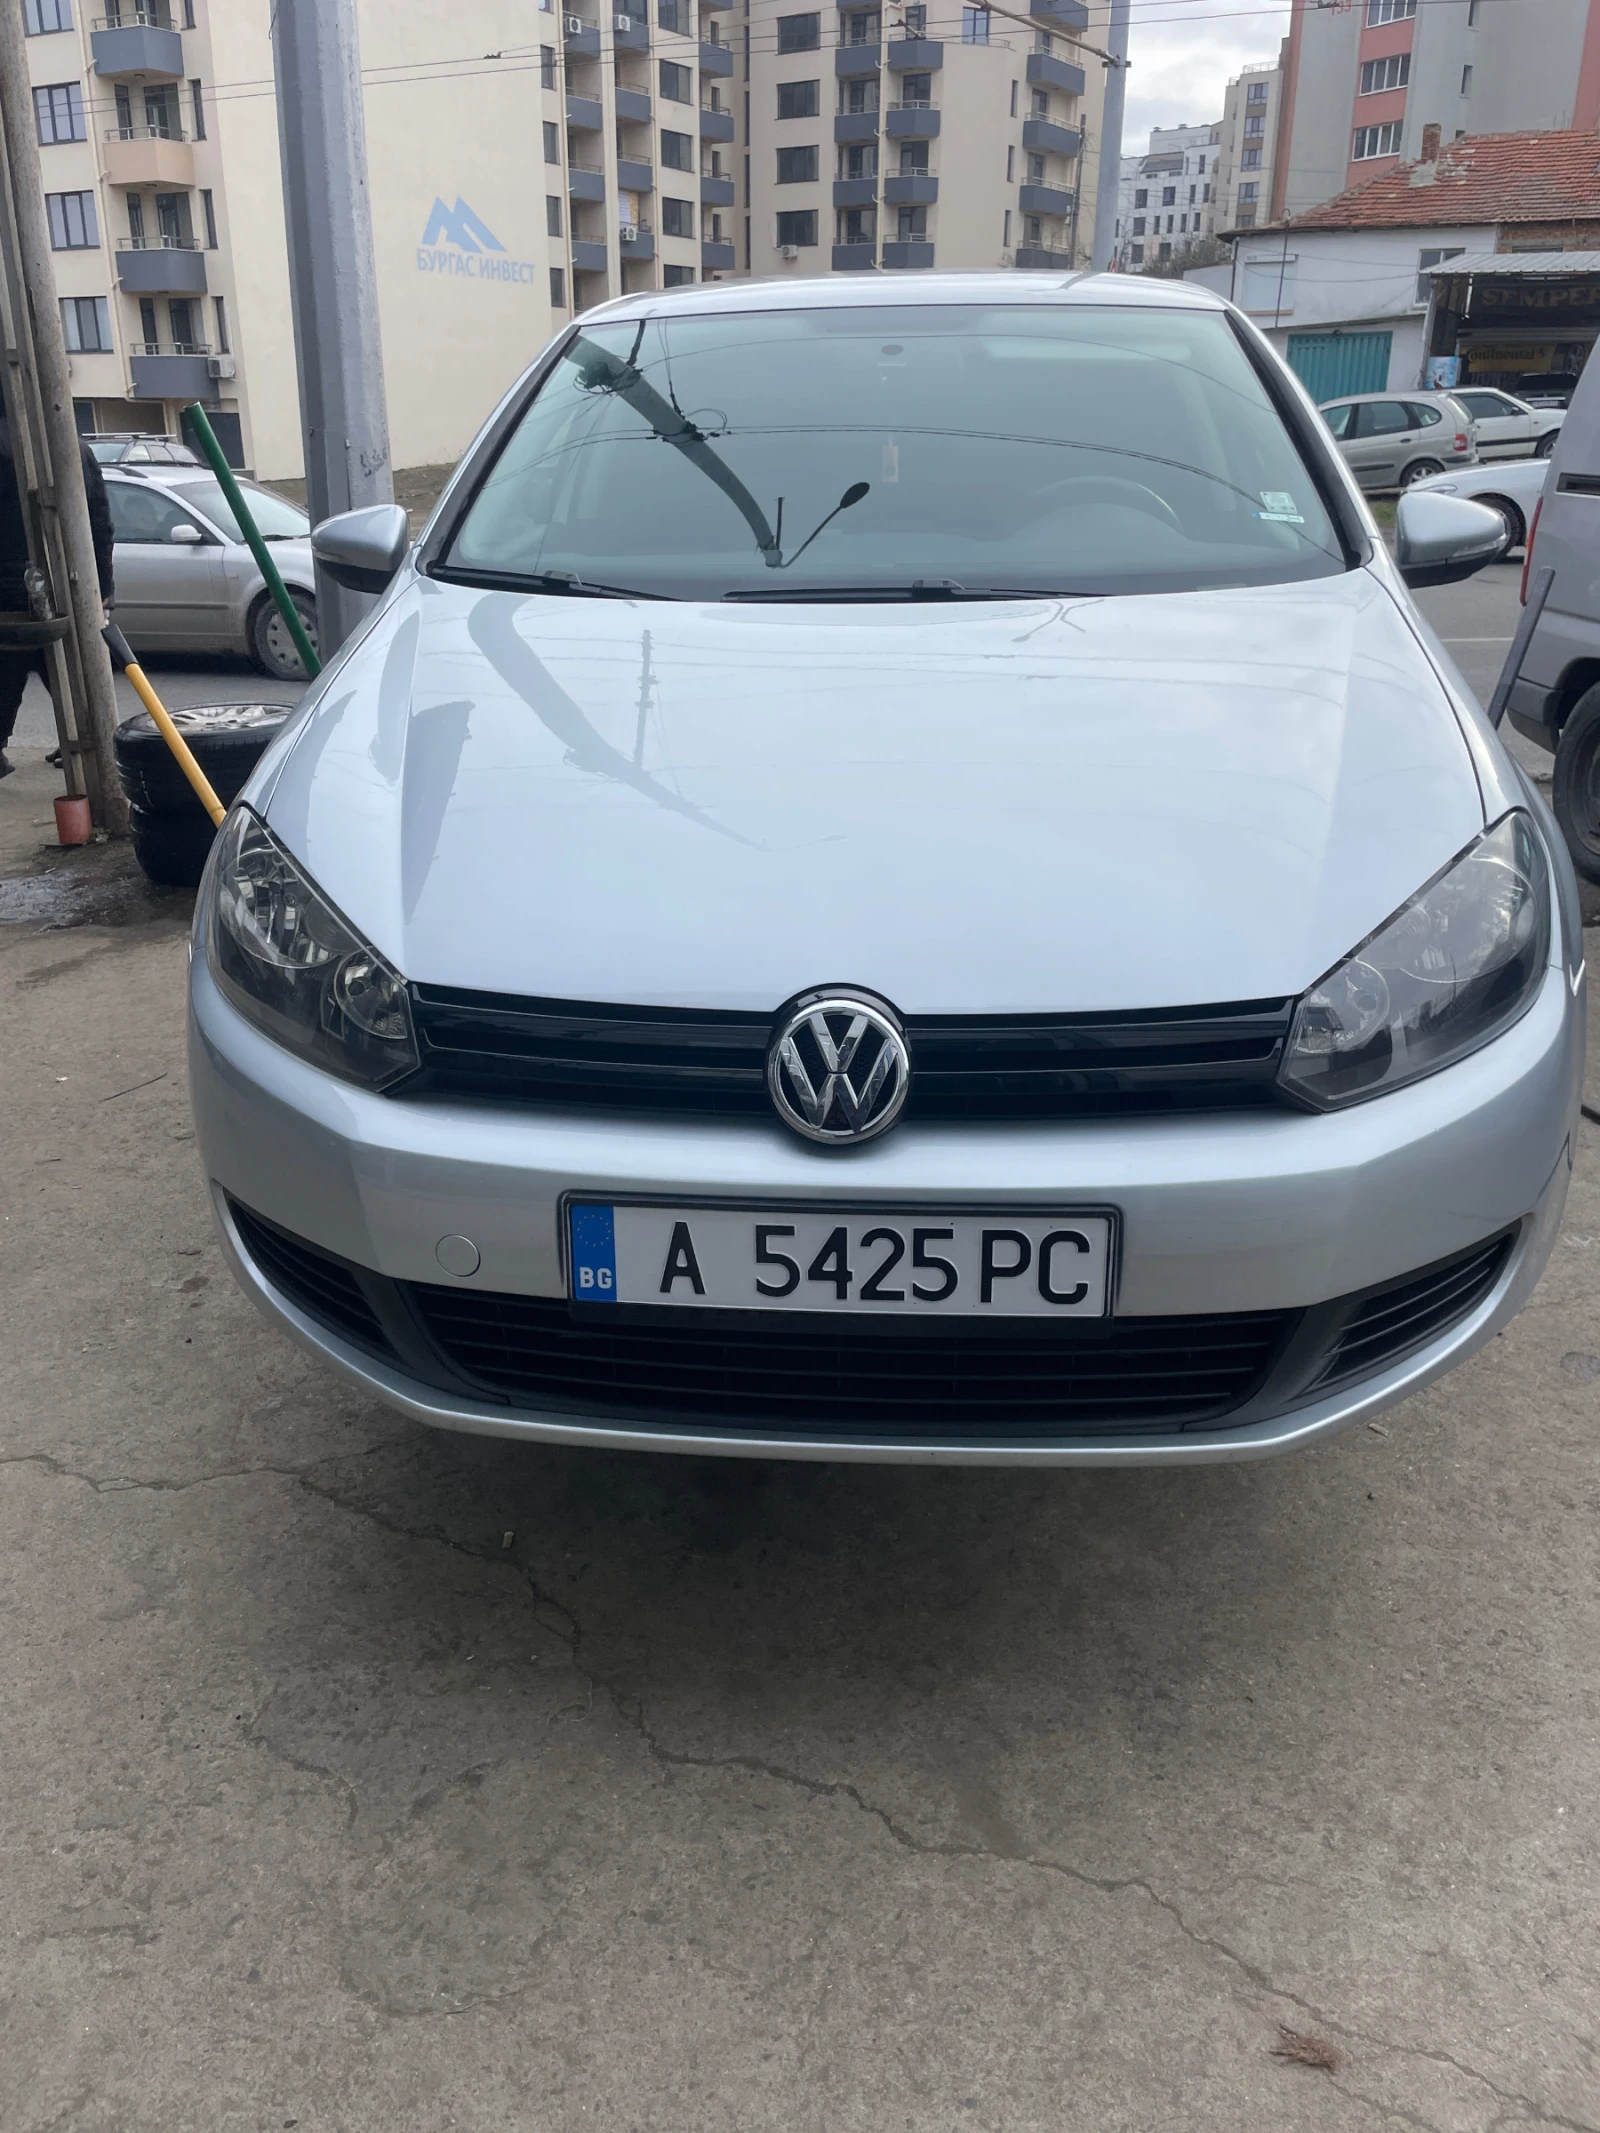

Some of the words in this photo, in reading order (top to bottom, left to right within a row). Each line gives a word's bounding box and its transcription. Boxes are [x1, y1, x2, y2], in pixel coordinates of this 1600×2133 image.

[416, 248, 475, 277] БУРГАС
[479, 257, 535, 285] ИНВЕСТ
[580, 1267, 612, 1289] BG
[660, 1221, 706, 1295] A
[756, 1224, 958, 1302] 5425
